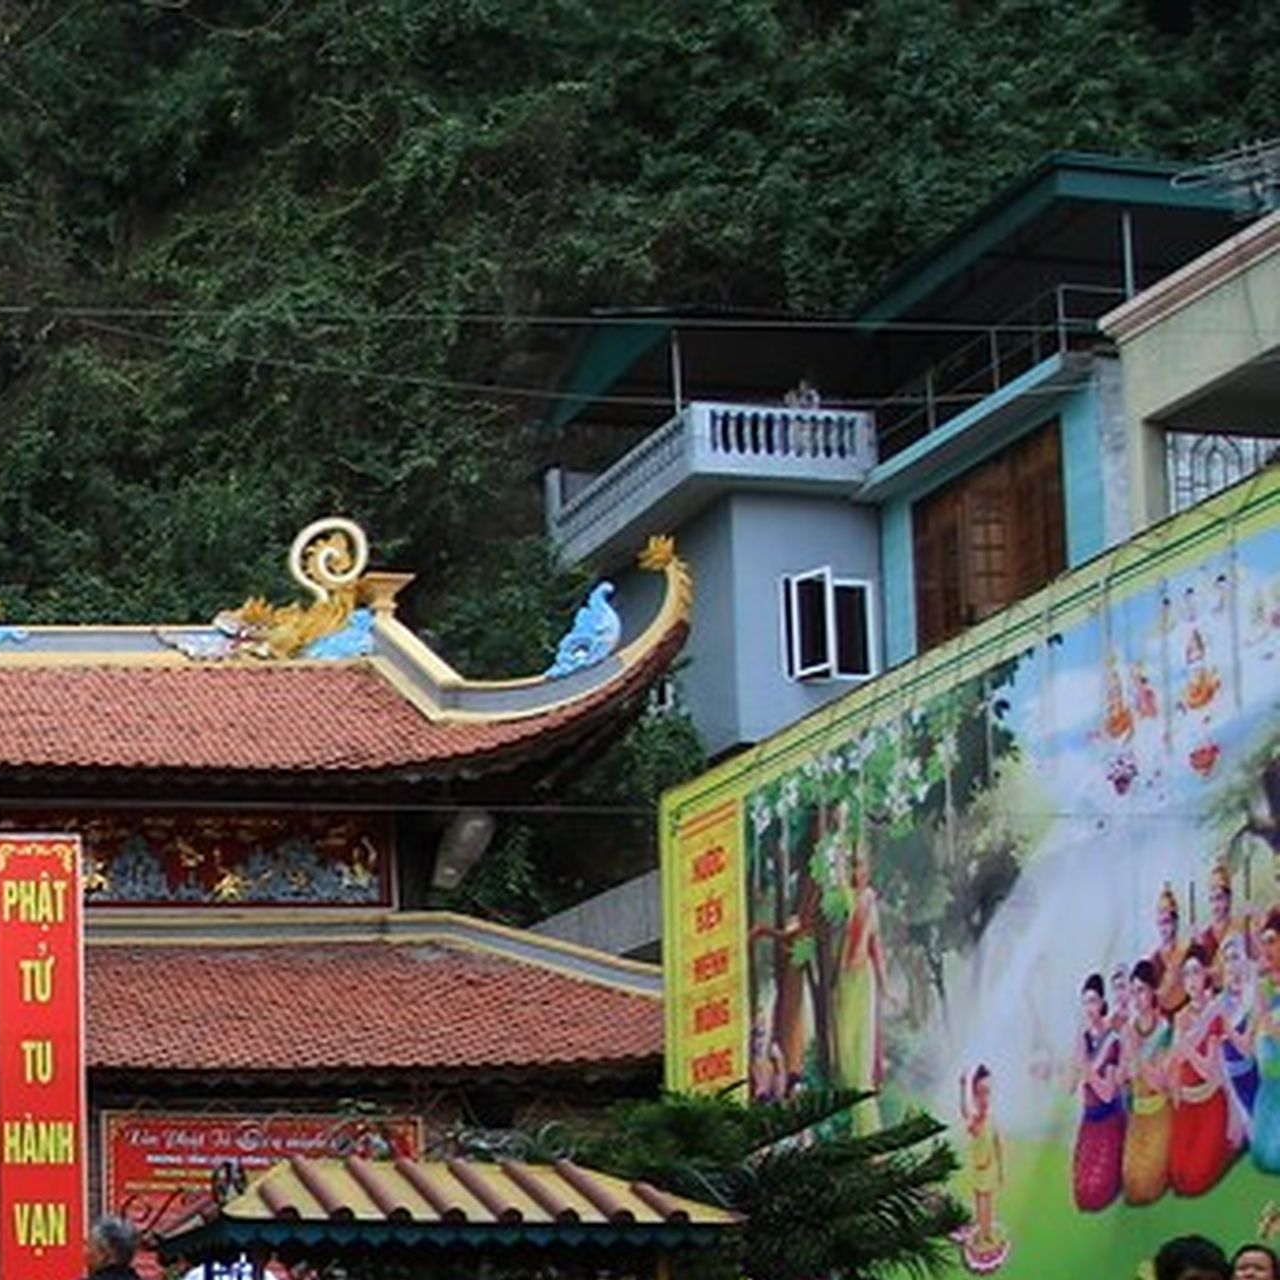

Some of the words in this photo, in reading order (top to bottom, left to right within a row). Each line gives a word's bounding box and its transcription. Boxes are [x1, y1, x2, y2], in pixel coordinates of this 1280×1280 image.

[2, 870, 66, 932] PHẬT
[20, 1040, 53, 1084] TU
[3, 1111, 75, 1164] HÀNH
[13, 1203, 67, 1257] VẠN
